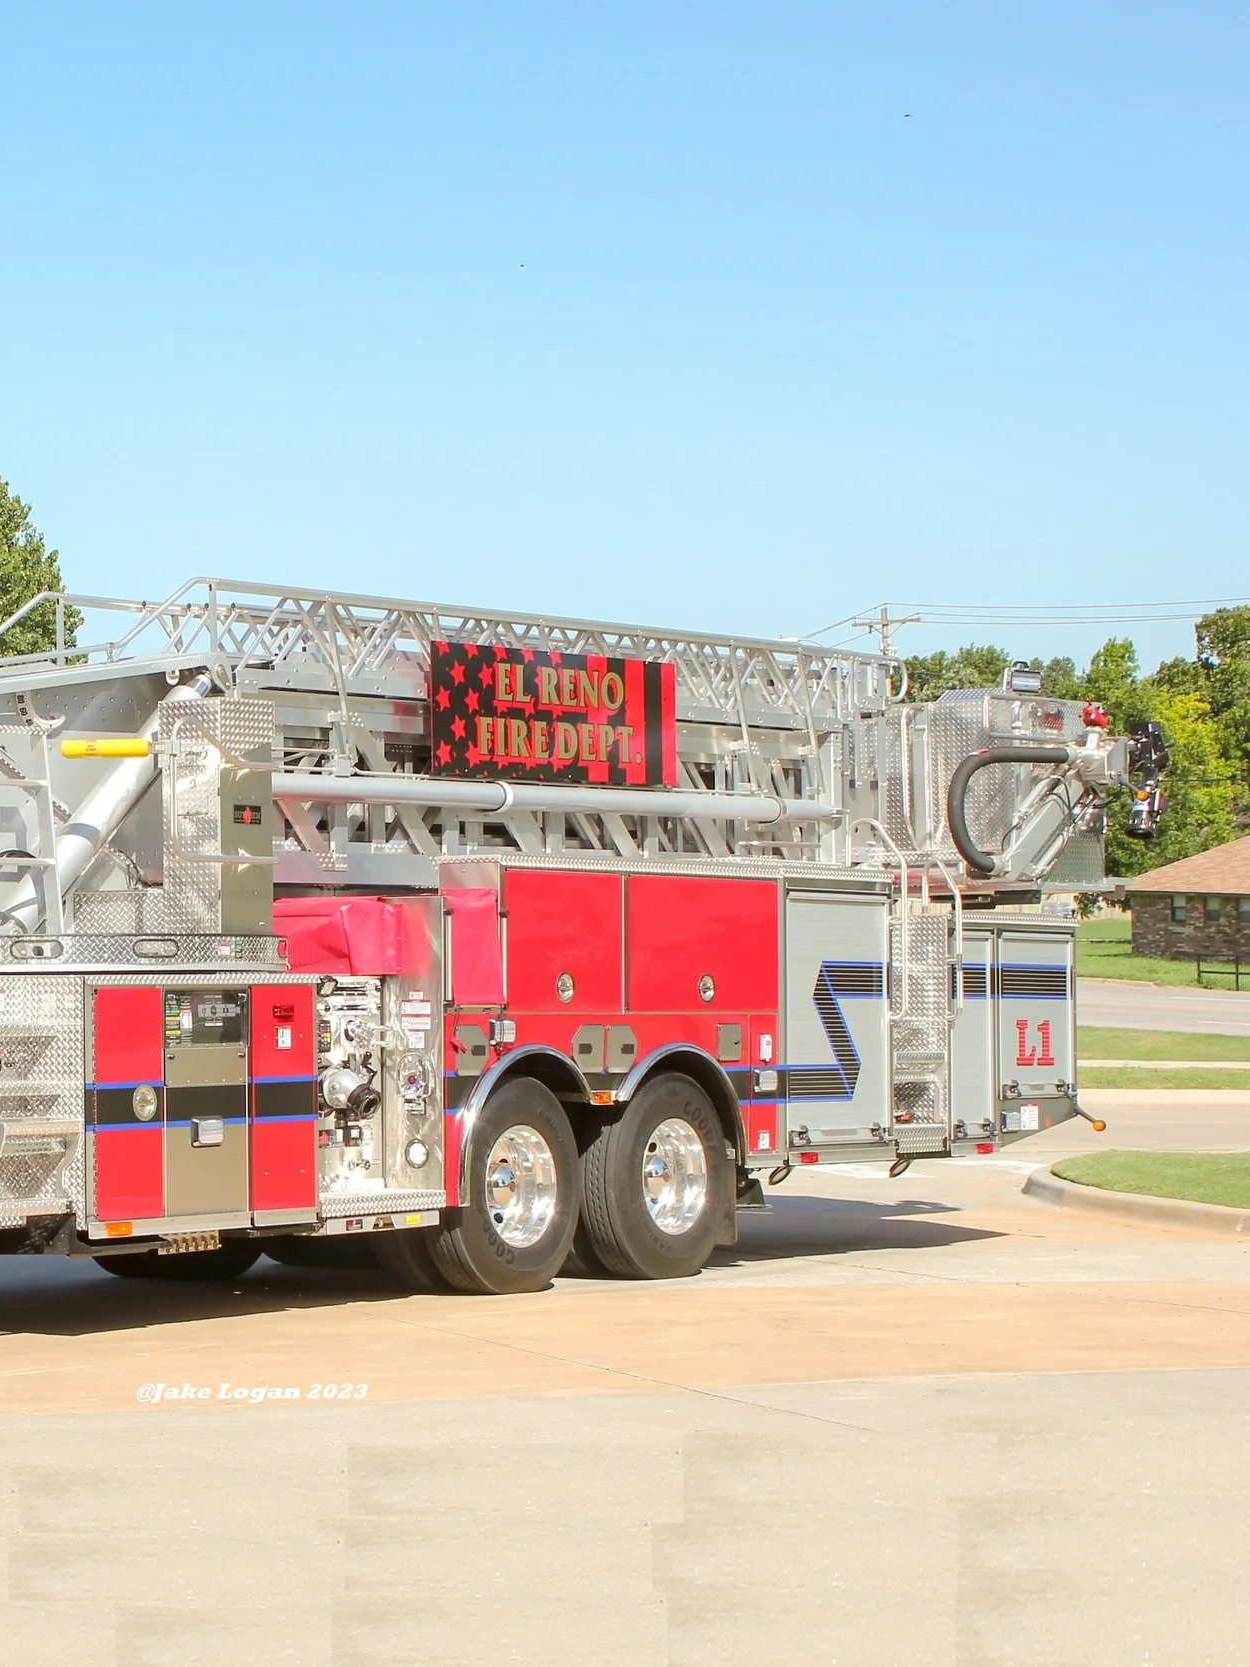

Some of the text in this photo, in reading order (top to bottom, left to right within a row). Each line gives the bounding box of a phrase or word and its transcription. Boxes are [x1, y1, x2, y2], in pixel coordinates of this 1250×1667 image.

[496, 661, 625, 711] EL RENO
[477, 714, 645, 766] FIRE DEPT.
[1016, 1019, 1055, 1066] L1
